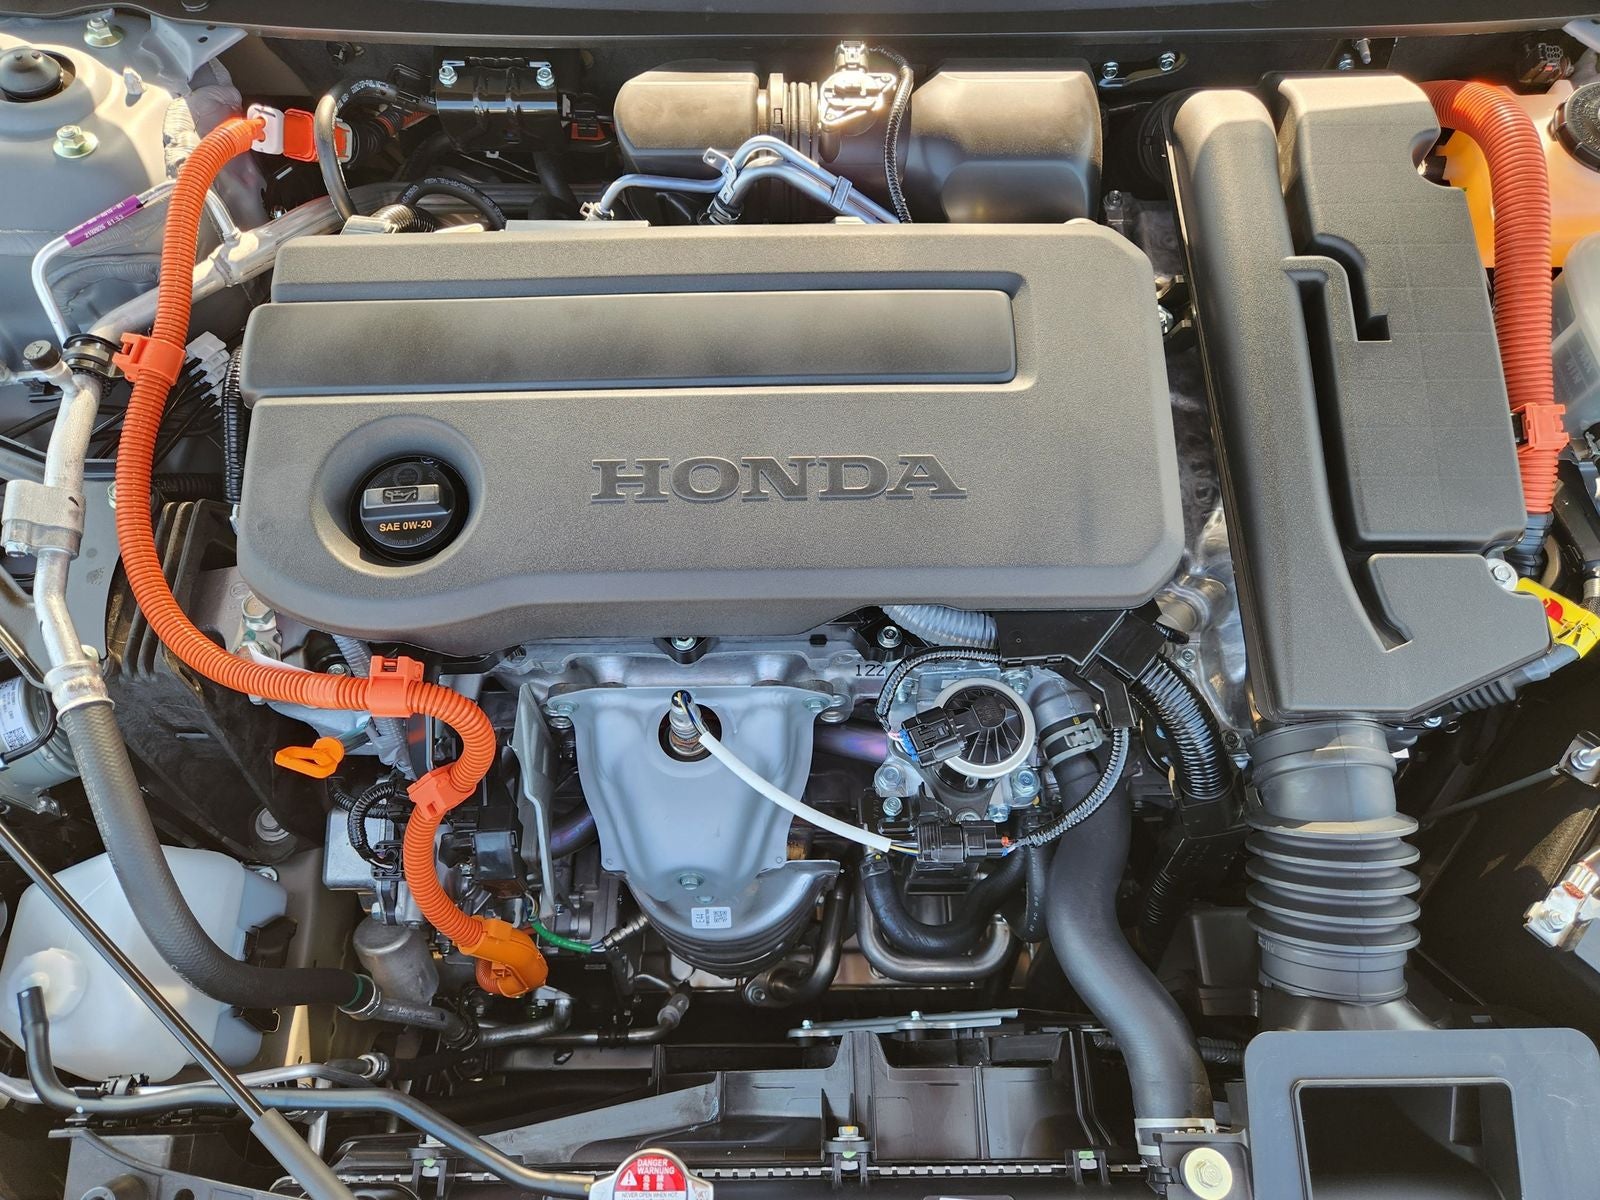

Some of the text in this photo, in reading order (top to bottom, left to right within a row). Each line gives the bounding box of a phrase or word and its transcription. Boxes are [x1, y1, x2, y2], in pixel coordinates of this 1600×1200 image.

[591, 454, 967, 502] HONDA
[379, 520, 432, 532] SAE 0W-20
[855, 664, 886, 677] 122
[637, 1159, 668, 1167] DANGER
[637, 1166, 675, 1175] WARNUNG
